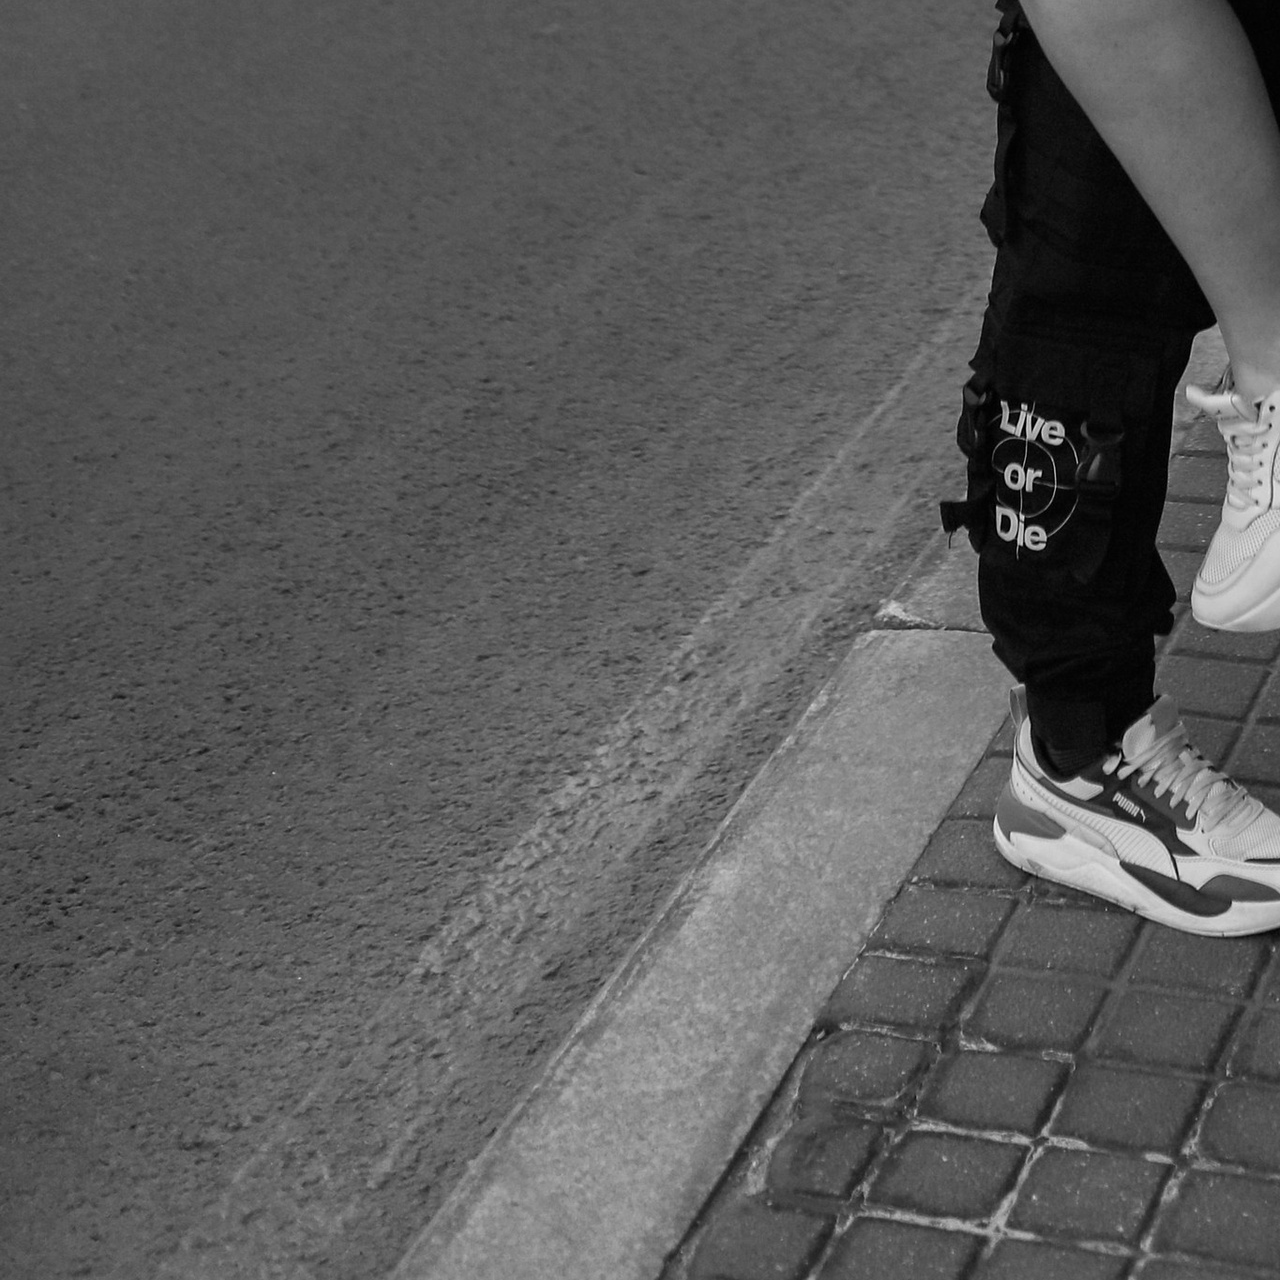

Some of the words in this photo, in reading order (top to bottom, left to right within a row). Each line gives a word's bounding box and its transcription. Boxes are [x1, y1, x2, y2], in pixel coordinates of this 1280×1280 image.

[1000, 400, 1065, 446] Live
[1003, 462, 1042, 492] or
[995, 504, 1048, 551] Die
[1112, 790, 1140, 817] PUMA
